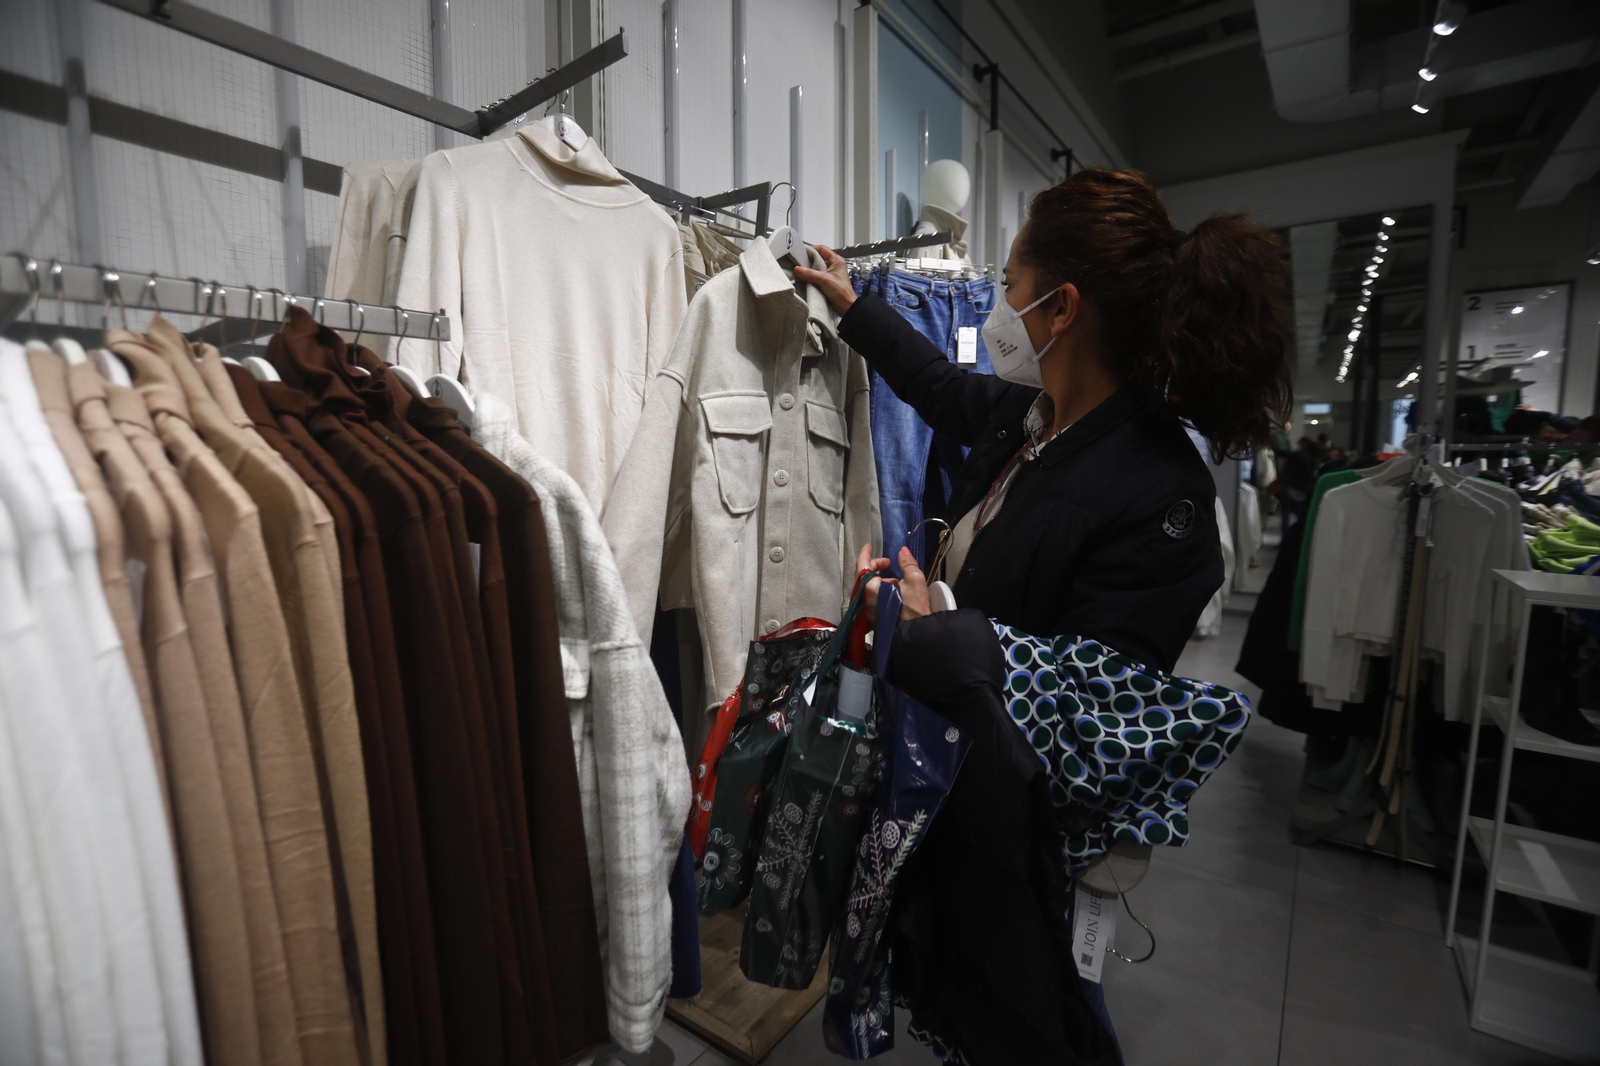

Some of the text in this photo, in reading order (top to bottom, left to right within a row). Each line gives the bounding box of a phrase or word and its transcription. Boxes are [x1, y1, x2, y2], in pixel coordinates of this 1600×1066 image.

[1467, 296, 1481, 311] 2
[1466, 345, 1476, 359] 1
[1089, 889, 1103, 917] LIFE
[1083, 918, 1099, 951] JOIN
